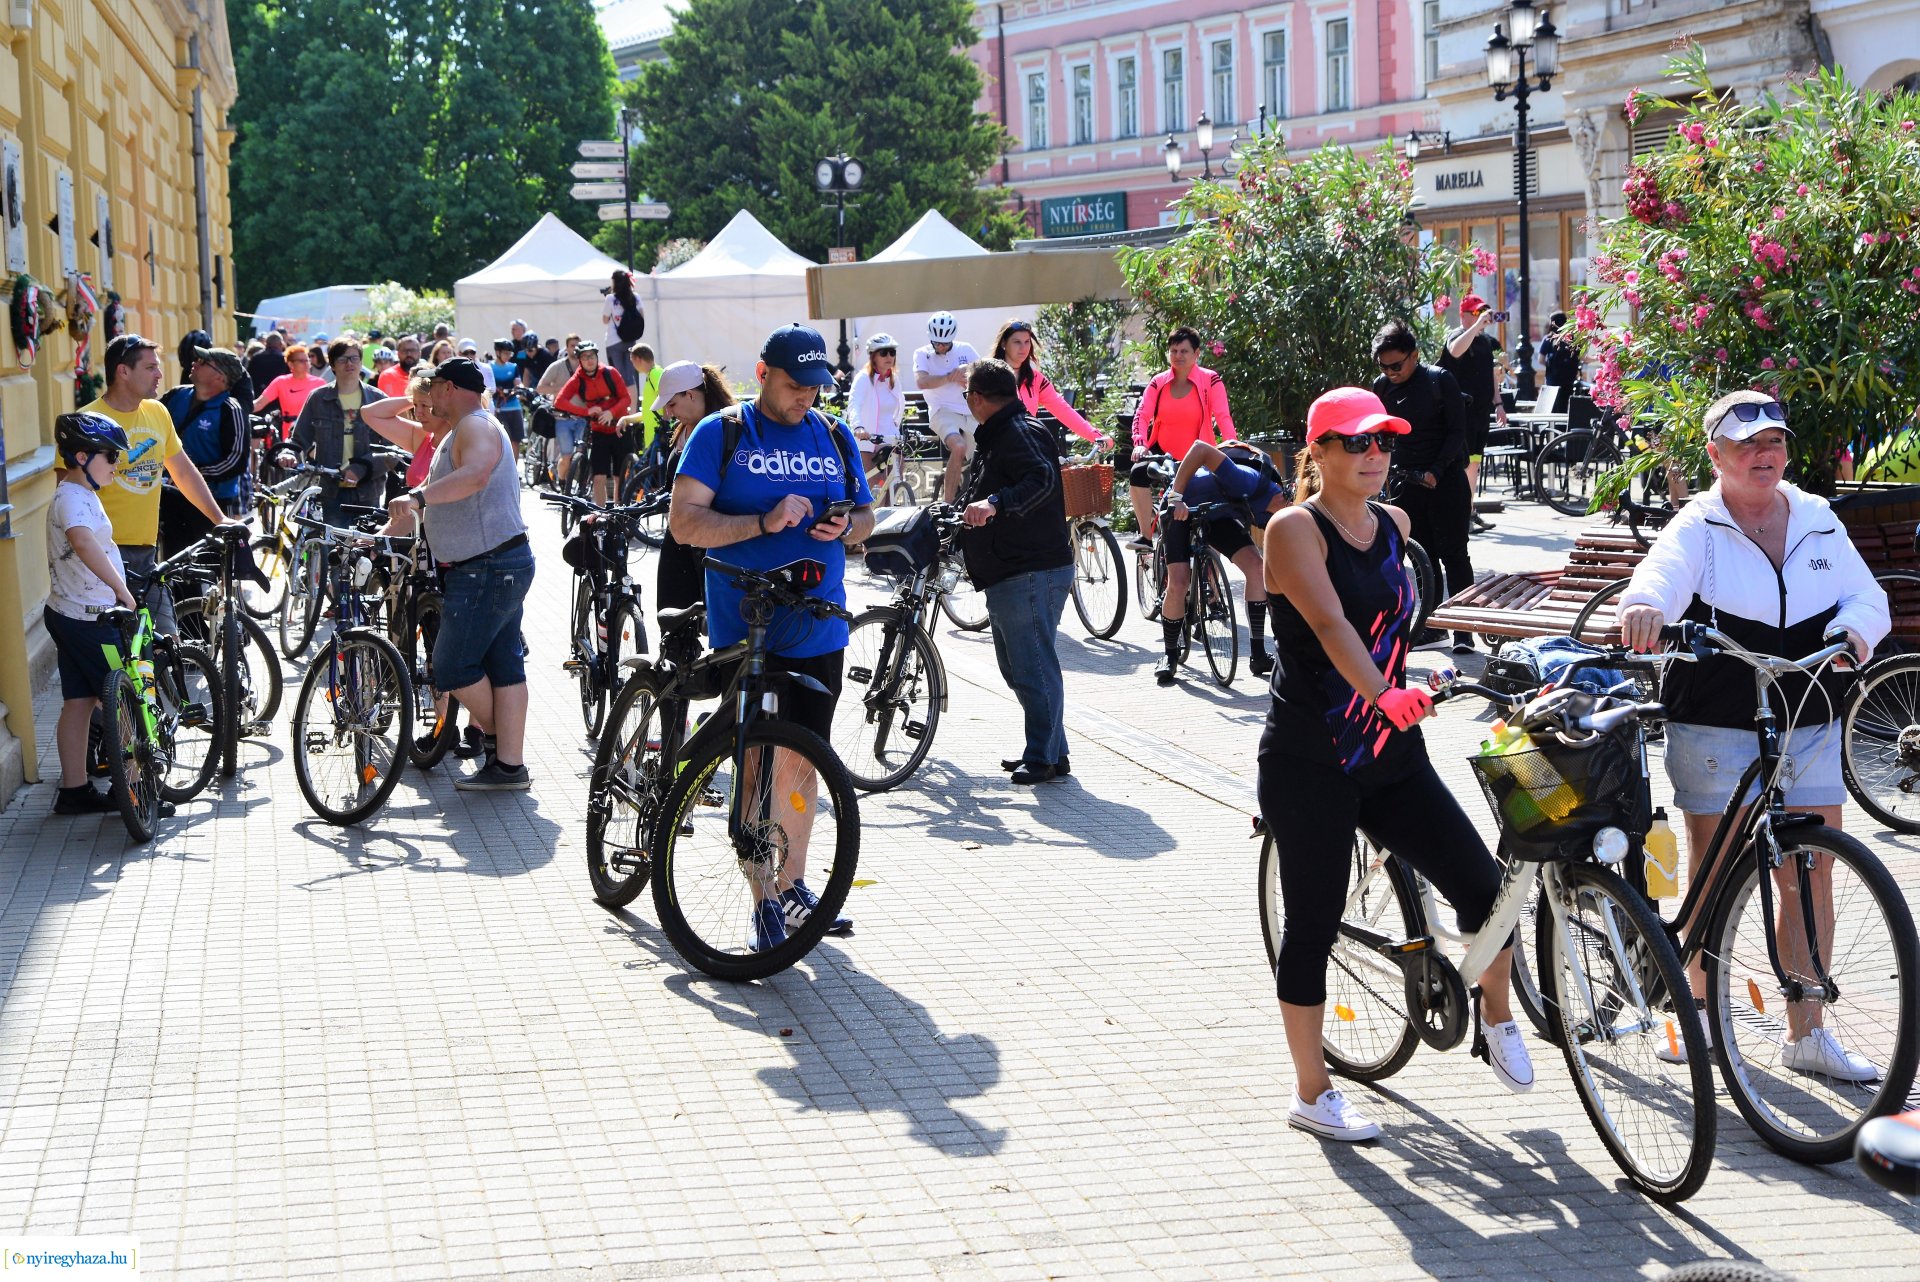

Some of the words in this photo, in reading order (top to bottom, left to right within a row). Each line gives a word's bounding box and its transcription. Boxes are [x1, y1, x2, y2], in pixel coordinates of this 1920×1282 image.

[1435, 169, 1484, 191] MARELLA
[1050, 197, 1115, 225] NYÍRSÉG
[747, 450, 839, 476] adidas
[1844, 769, 1861, 794] KENDA
